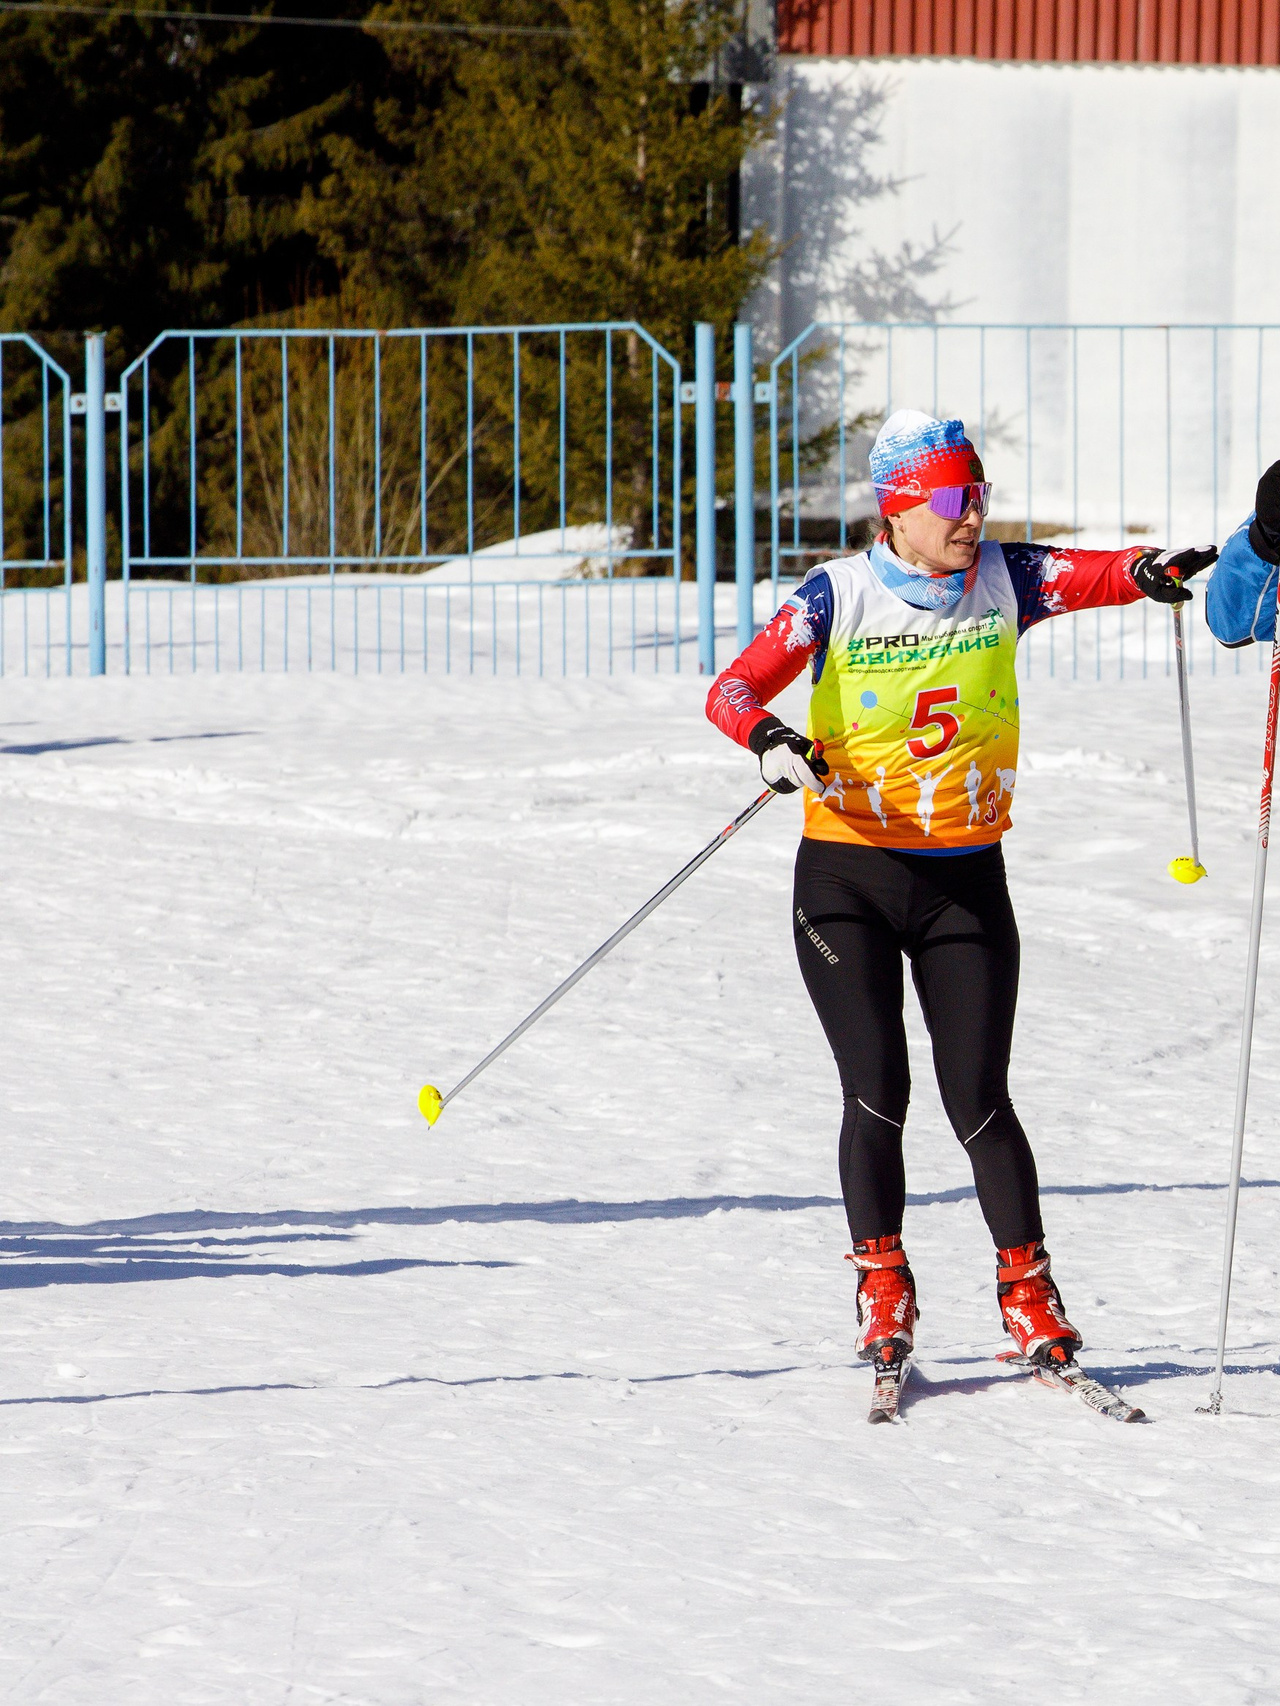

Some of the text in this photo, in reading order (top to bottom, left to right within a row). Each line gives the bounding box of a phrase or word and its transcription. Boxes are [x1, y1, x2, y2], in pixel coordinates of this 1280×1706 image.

[847, 634, 919, 652] #PRO
[847, 633, 1000, 667] ДВИЖЕНИЕ
[906, 685, 960, 760] 5
[984, 790, 998, 825] 3
[796, 907, 840, 965] noname
[892, 1290, 911, 1325] alpina
[1005, 1306, 1035, 1336] alpina
